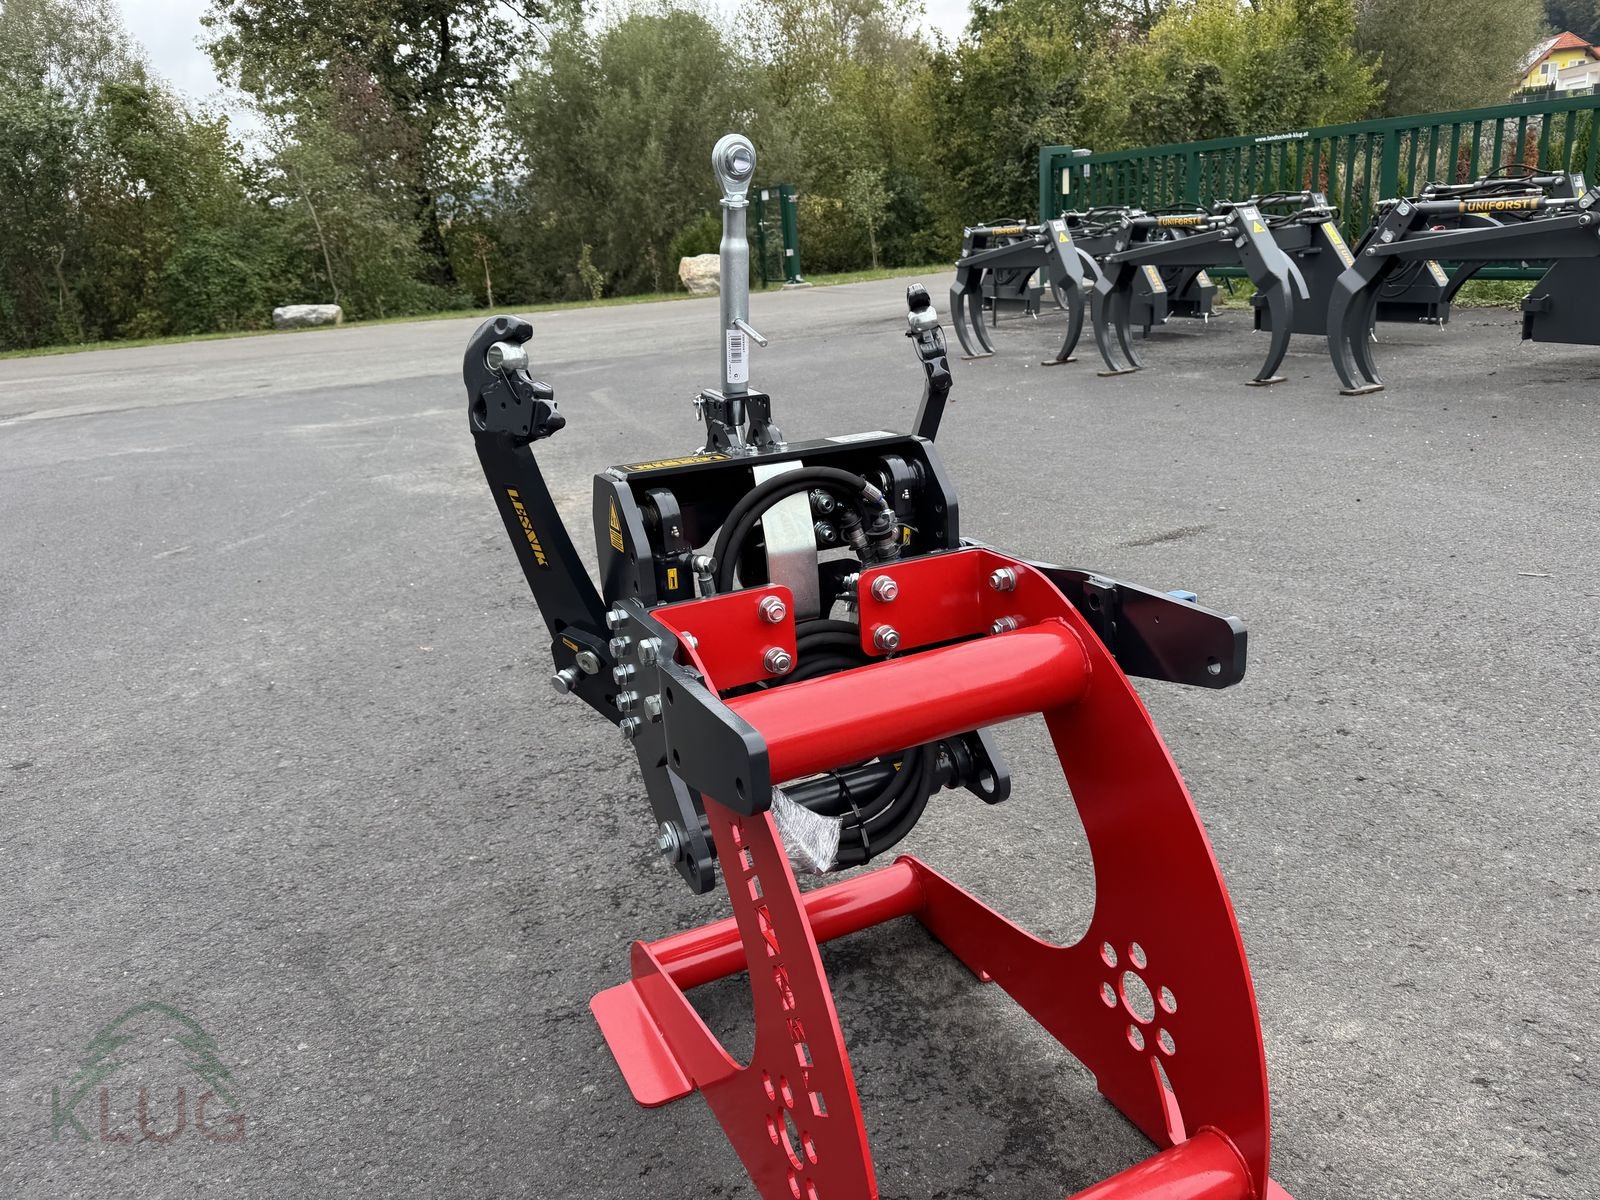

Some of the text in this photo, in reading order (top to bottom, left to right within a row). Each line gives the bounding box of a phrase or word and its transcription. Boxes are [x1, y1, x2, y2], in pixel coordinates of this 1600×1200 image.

[1467, 200, 1530, 212] UNIFORST
[1162, 214, 1197, 226] UNIFORST
[506, 488, 549, 567] LESNIK
